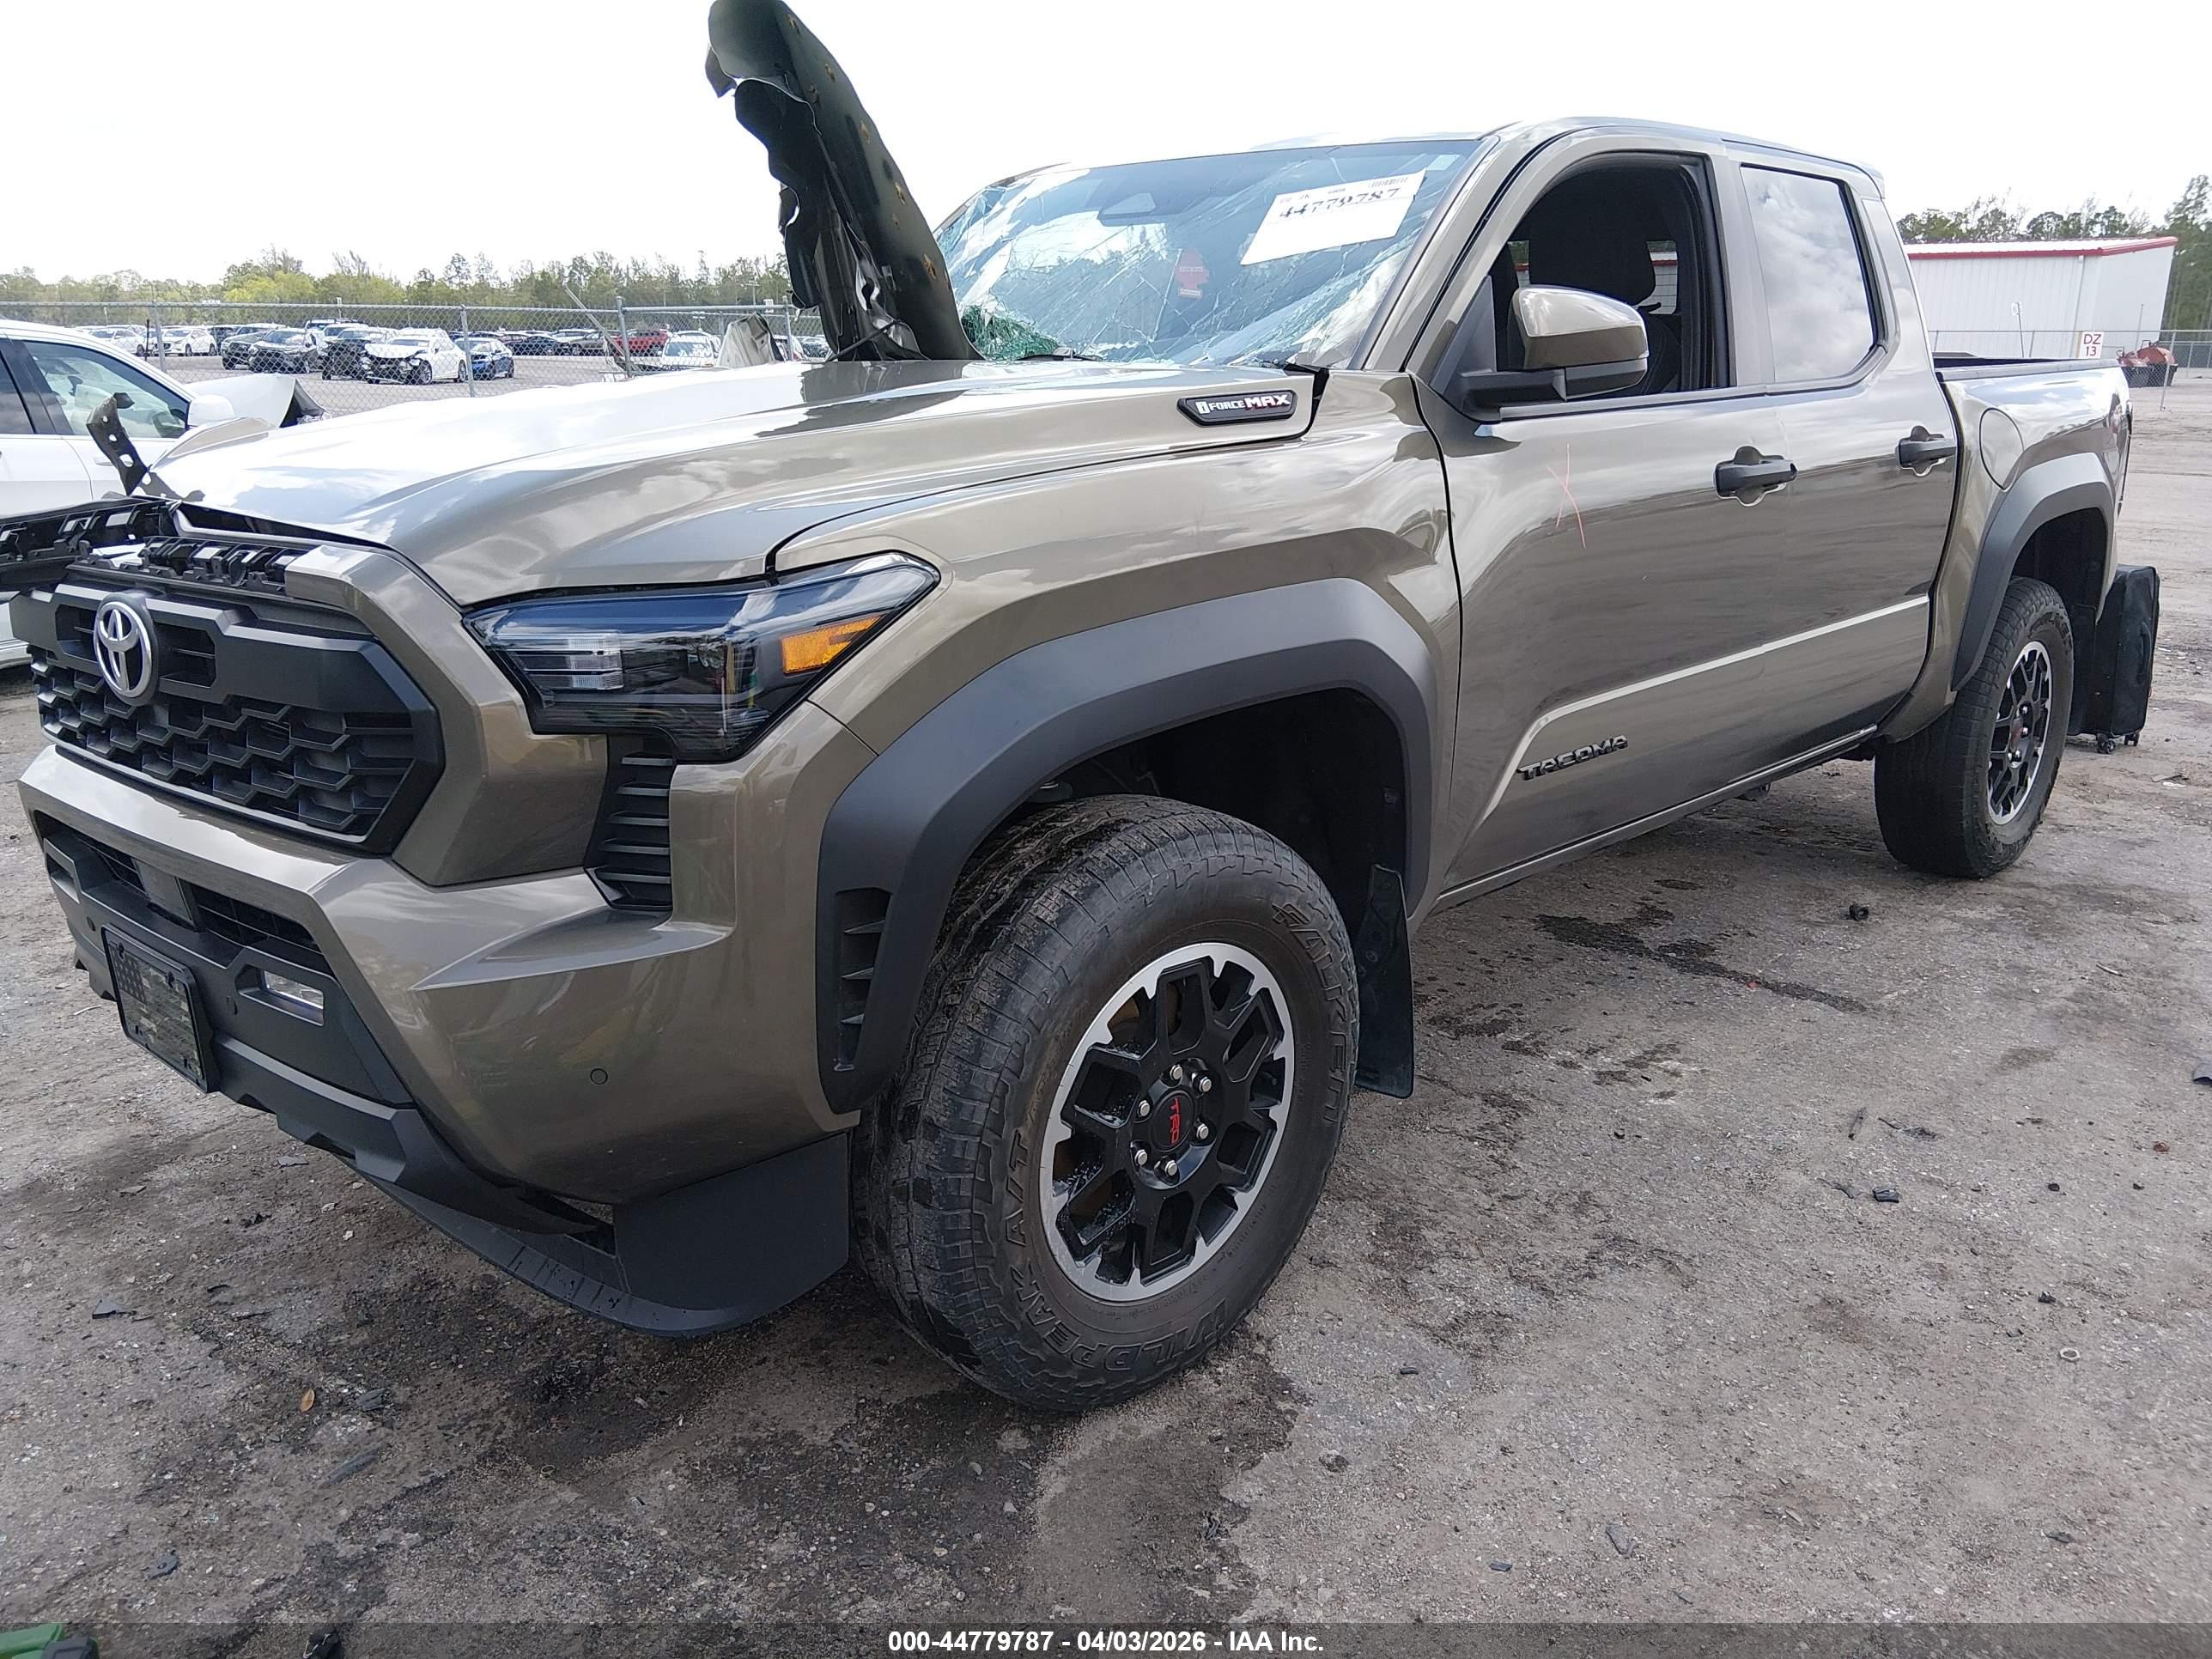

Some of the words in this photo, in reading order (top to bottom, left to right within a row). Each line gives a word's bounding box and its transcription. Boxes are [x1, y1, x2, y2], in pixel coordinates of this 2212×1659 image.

[1279, 187, 1401, 218] 44779787
[2083, 333, 2102, 344] DZ
[2086, 346, 2097, 356] 13
[1244, 393, 1291, 411] MAX
[1516, 734, 1629, 781] TACOMA
[1169, 1097, 1182, 1146] TRD
